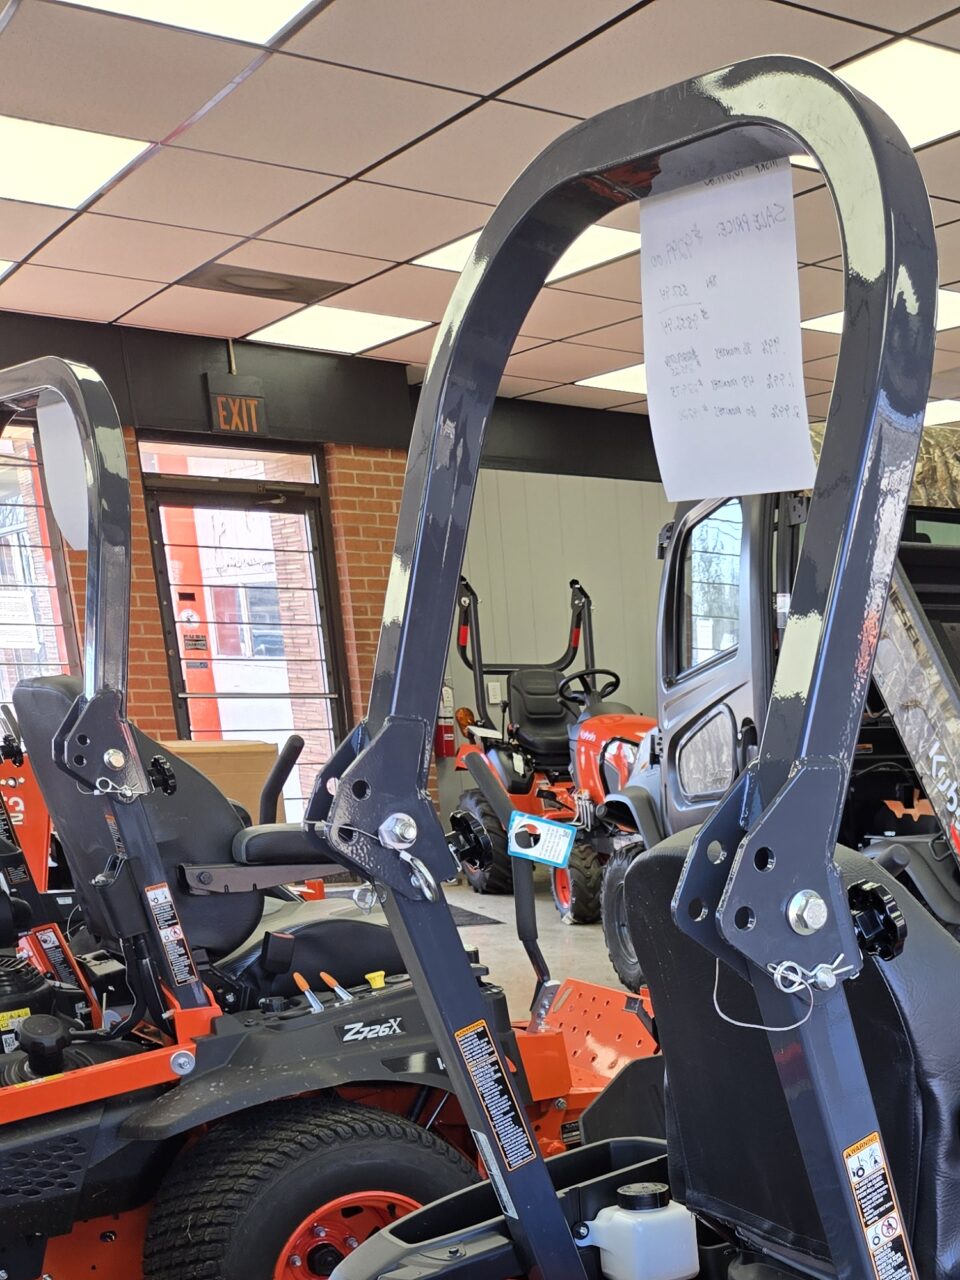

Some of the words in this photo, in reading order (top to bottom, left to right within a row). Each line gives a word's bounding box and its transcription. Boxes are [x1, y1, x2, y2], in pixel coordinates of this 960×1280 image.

[217, 397, 257, 432] EXIT
[889, 583, 923, 652] IESEL
[343, 1018, 402, 1042] Z726X
[850, 1134, 878, 1154] WARNING
